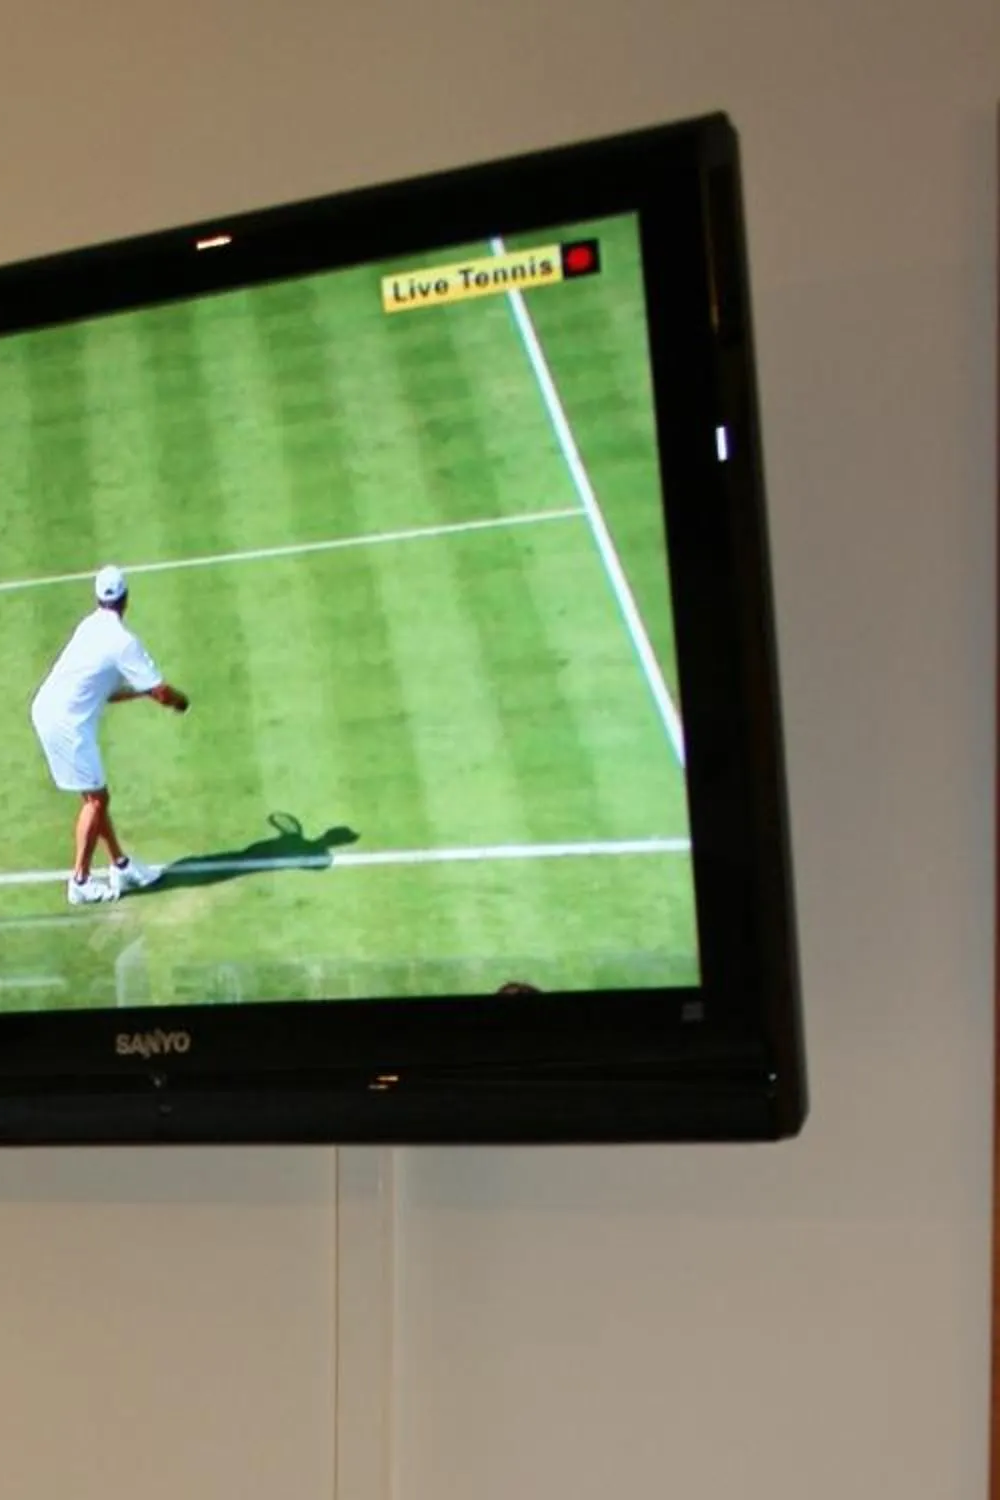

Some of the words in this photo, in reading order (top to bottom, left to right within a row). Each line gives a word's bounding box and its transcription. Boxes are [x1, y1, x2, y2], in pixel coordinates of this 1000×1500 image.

[392, 278, 449, 303] Live
[458, 256, 554, 289] Tennis
[115, 1028, 191, 1059] SANYO
